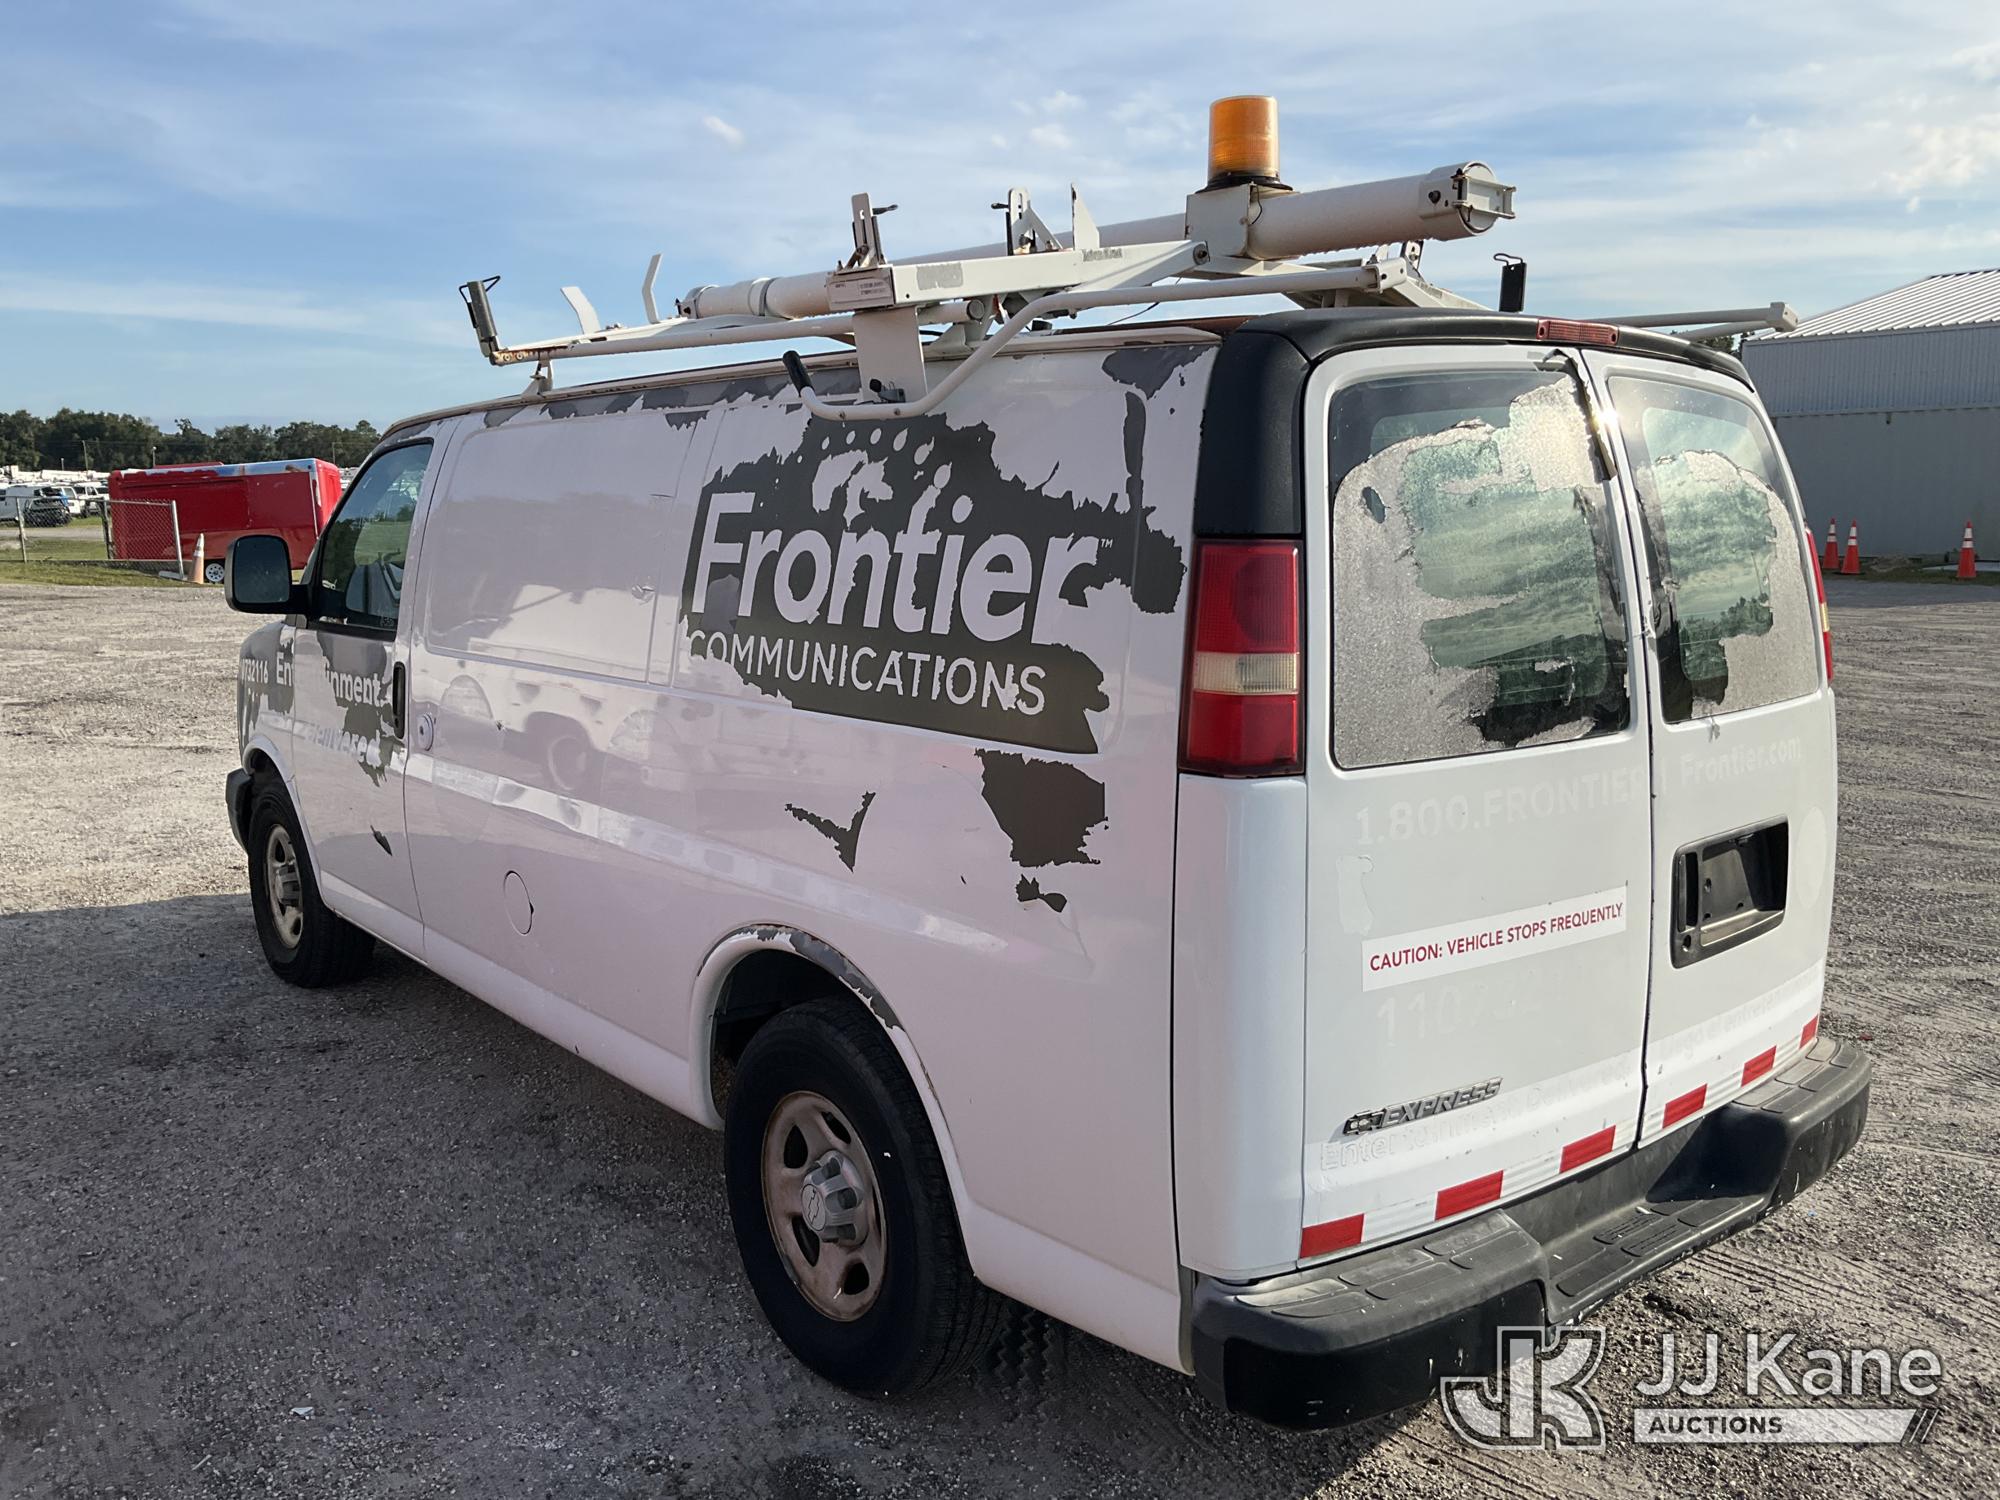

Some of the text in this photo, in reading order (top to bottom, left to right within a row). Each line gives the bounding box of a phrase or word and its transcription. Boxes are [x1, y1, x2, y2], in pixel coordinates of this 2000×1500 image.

[691, 488, 1098, 645] Frontier
[688, 630, 1046, 716] COMMUNICATIONS
[1680, 736, 1801, 786] Frontier.com
[1370, 902, 1623, 971] CAUTION: VEHICLE STOPS FREQUENTLY
[1381, 1078, 1503, 1127] EXPRESS
